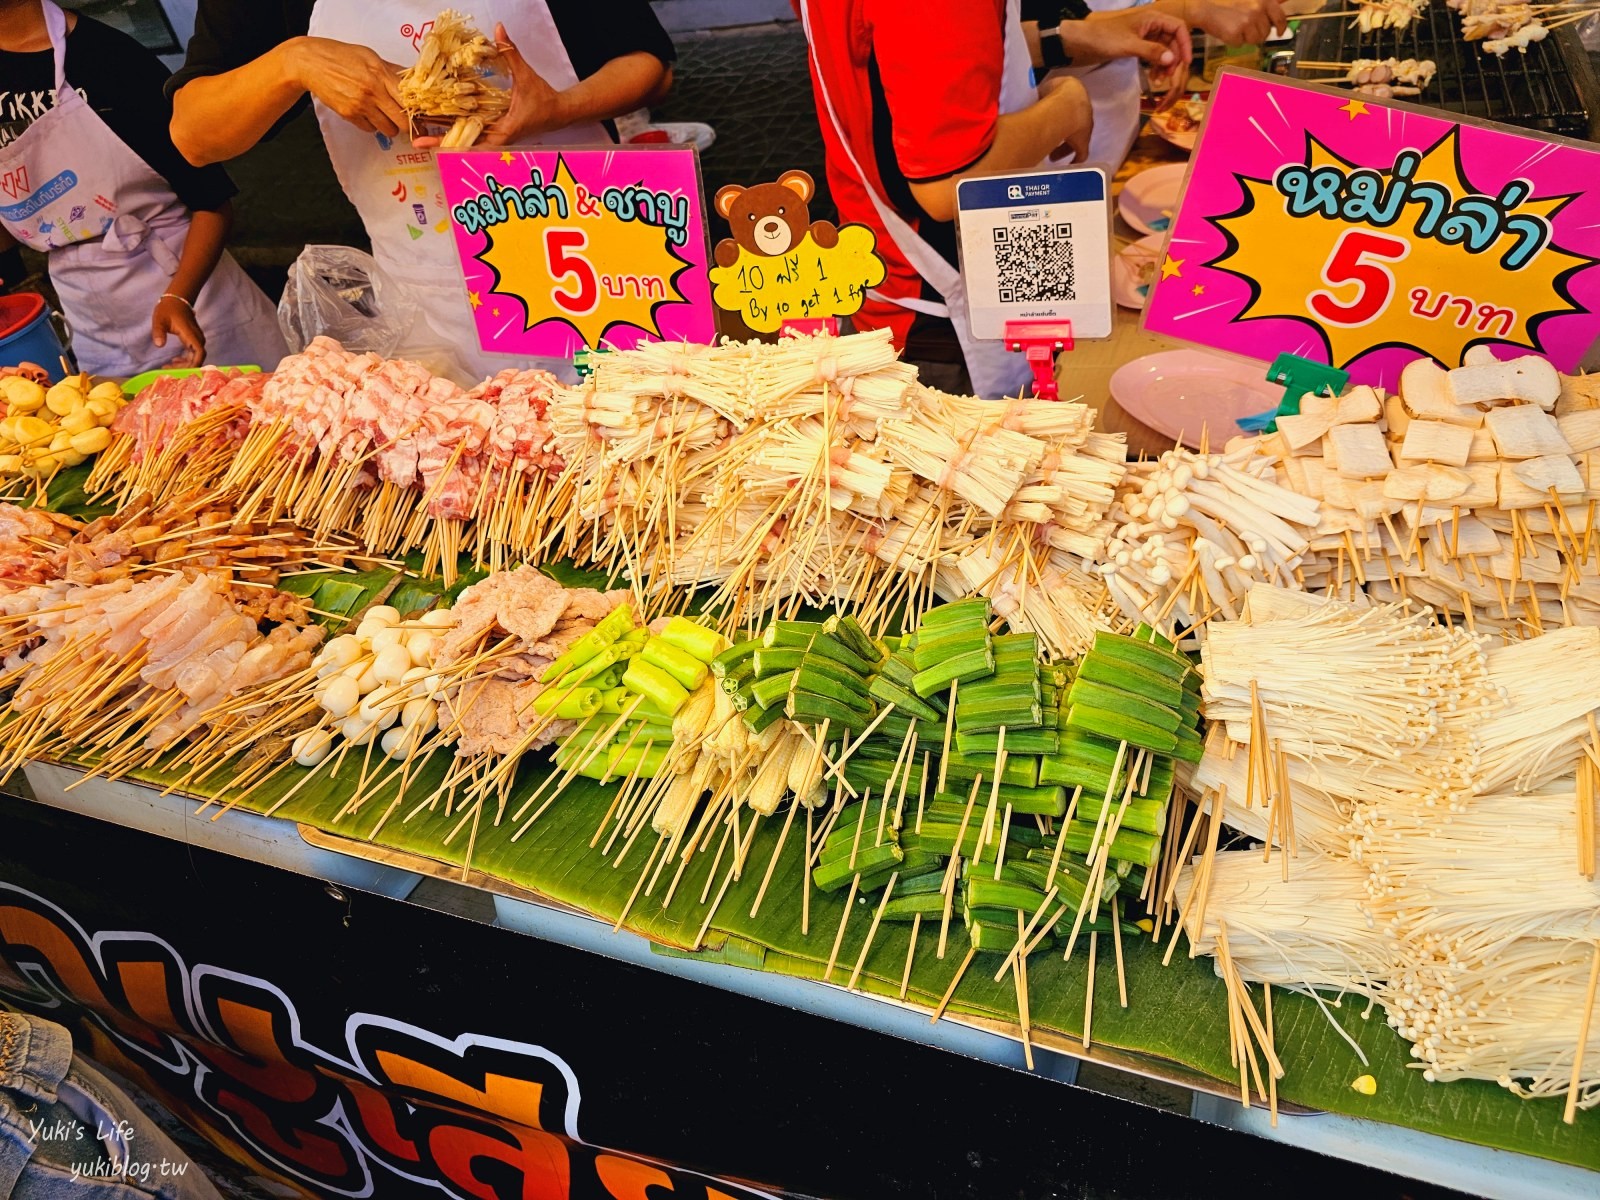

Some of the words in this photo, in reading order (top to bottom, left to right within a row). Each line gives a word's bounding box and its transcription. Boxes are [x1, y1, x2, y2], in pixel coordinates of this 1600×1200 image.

[453, 167, 569, 234] หม่าล่า
[576, 185, 602, 218] &
[602, 186, 690, 246] ชาบู
[1274, 149, 1550, 270] หม่าล่า
[544, 228, 600, 316] 5
[602, 275, 666, 299] บาท
[737, 265, 764, 293] 10
[816, 257, 828, 281] 1
[749, 298, 768, 321] By
[776, 301, 790, 316] 10
[801, 288, 820, 317] get
[833, 287, 843, 304] 1
[1308, 230, 1408, 326] 5
[1410, 288, 1516, 337] บาท
